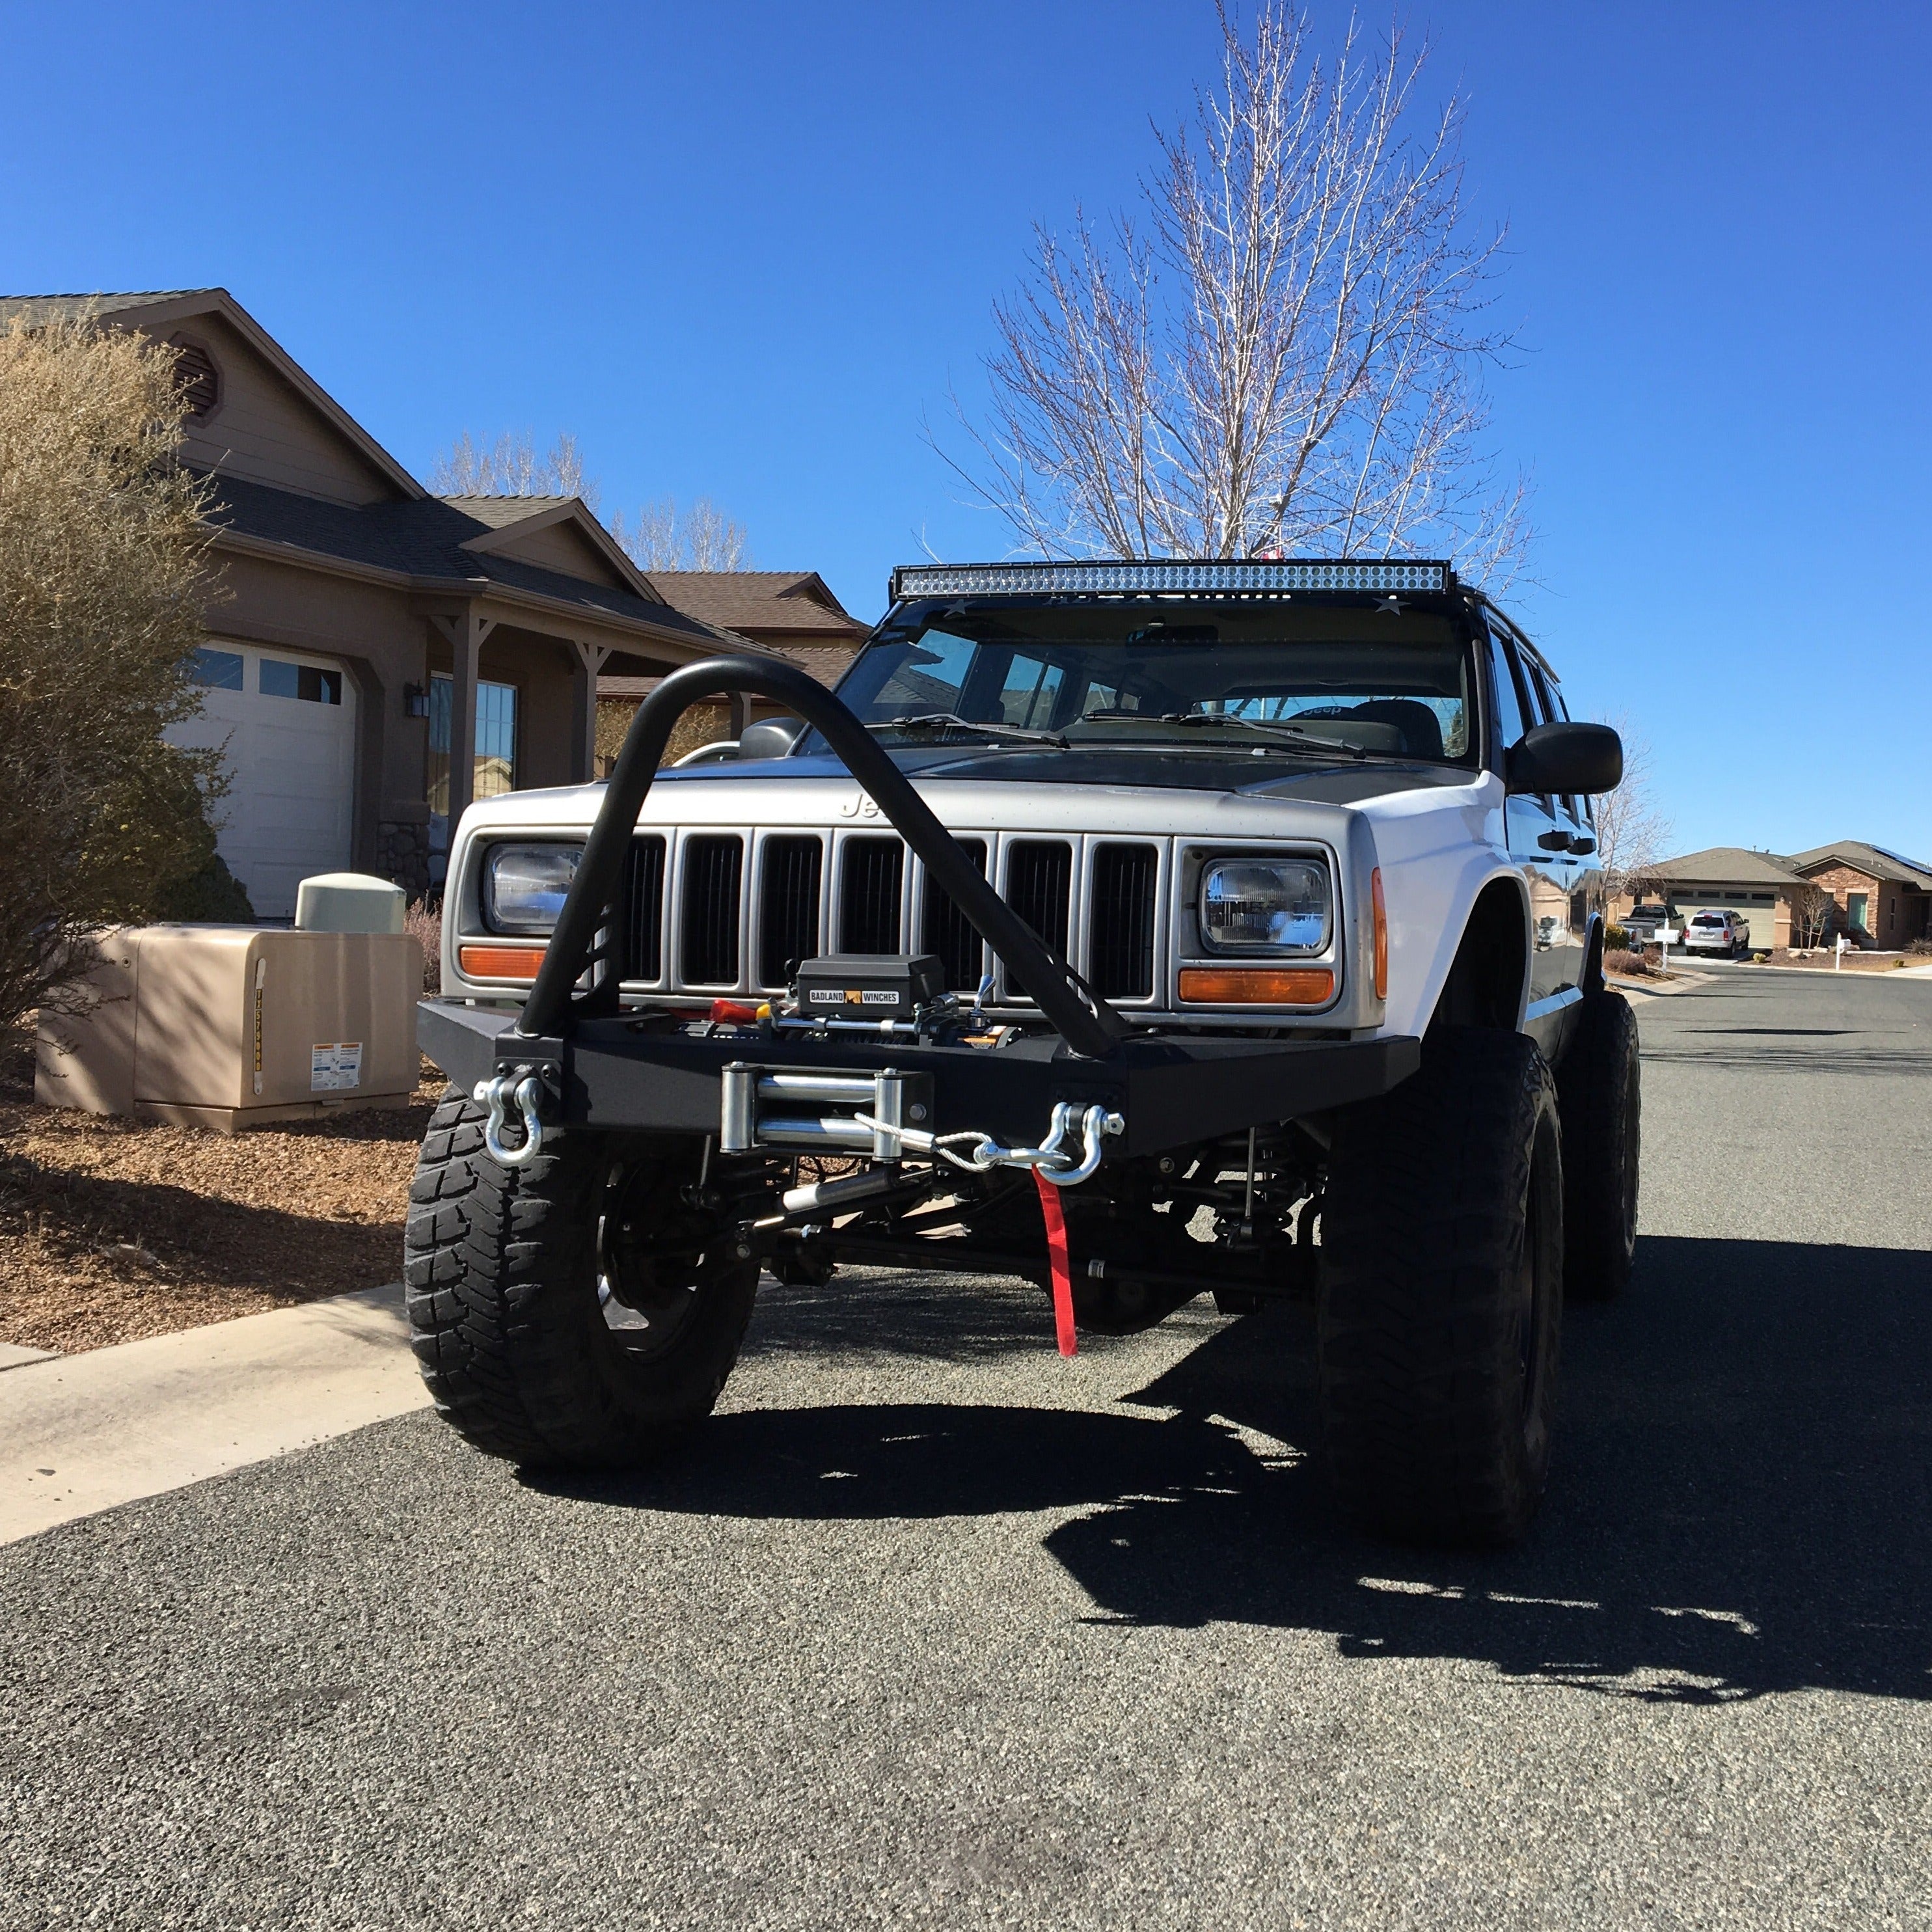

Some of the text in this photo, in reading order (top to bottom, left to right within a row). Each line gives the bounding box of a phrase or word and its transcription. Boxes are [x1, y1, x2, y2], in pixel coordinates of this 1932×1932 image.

[839, 793, 887, 818] Je
[811, 992, 897, 1002] BADLAND WINCHES
